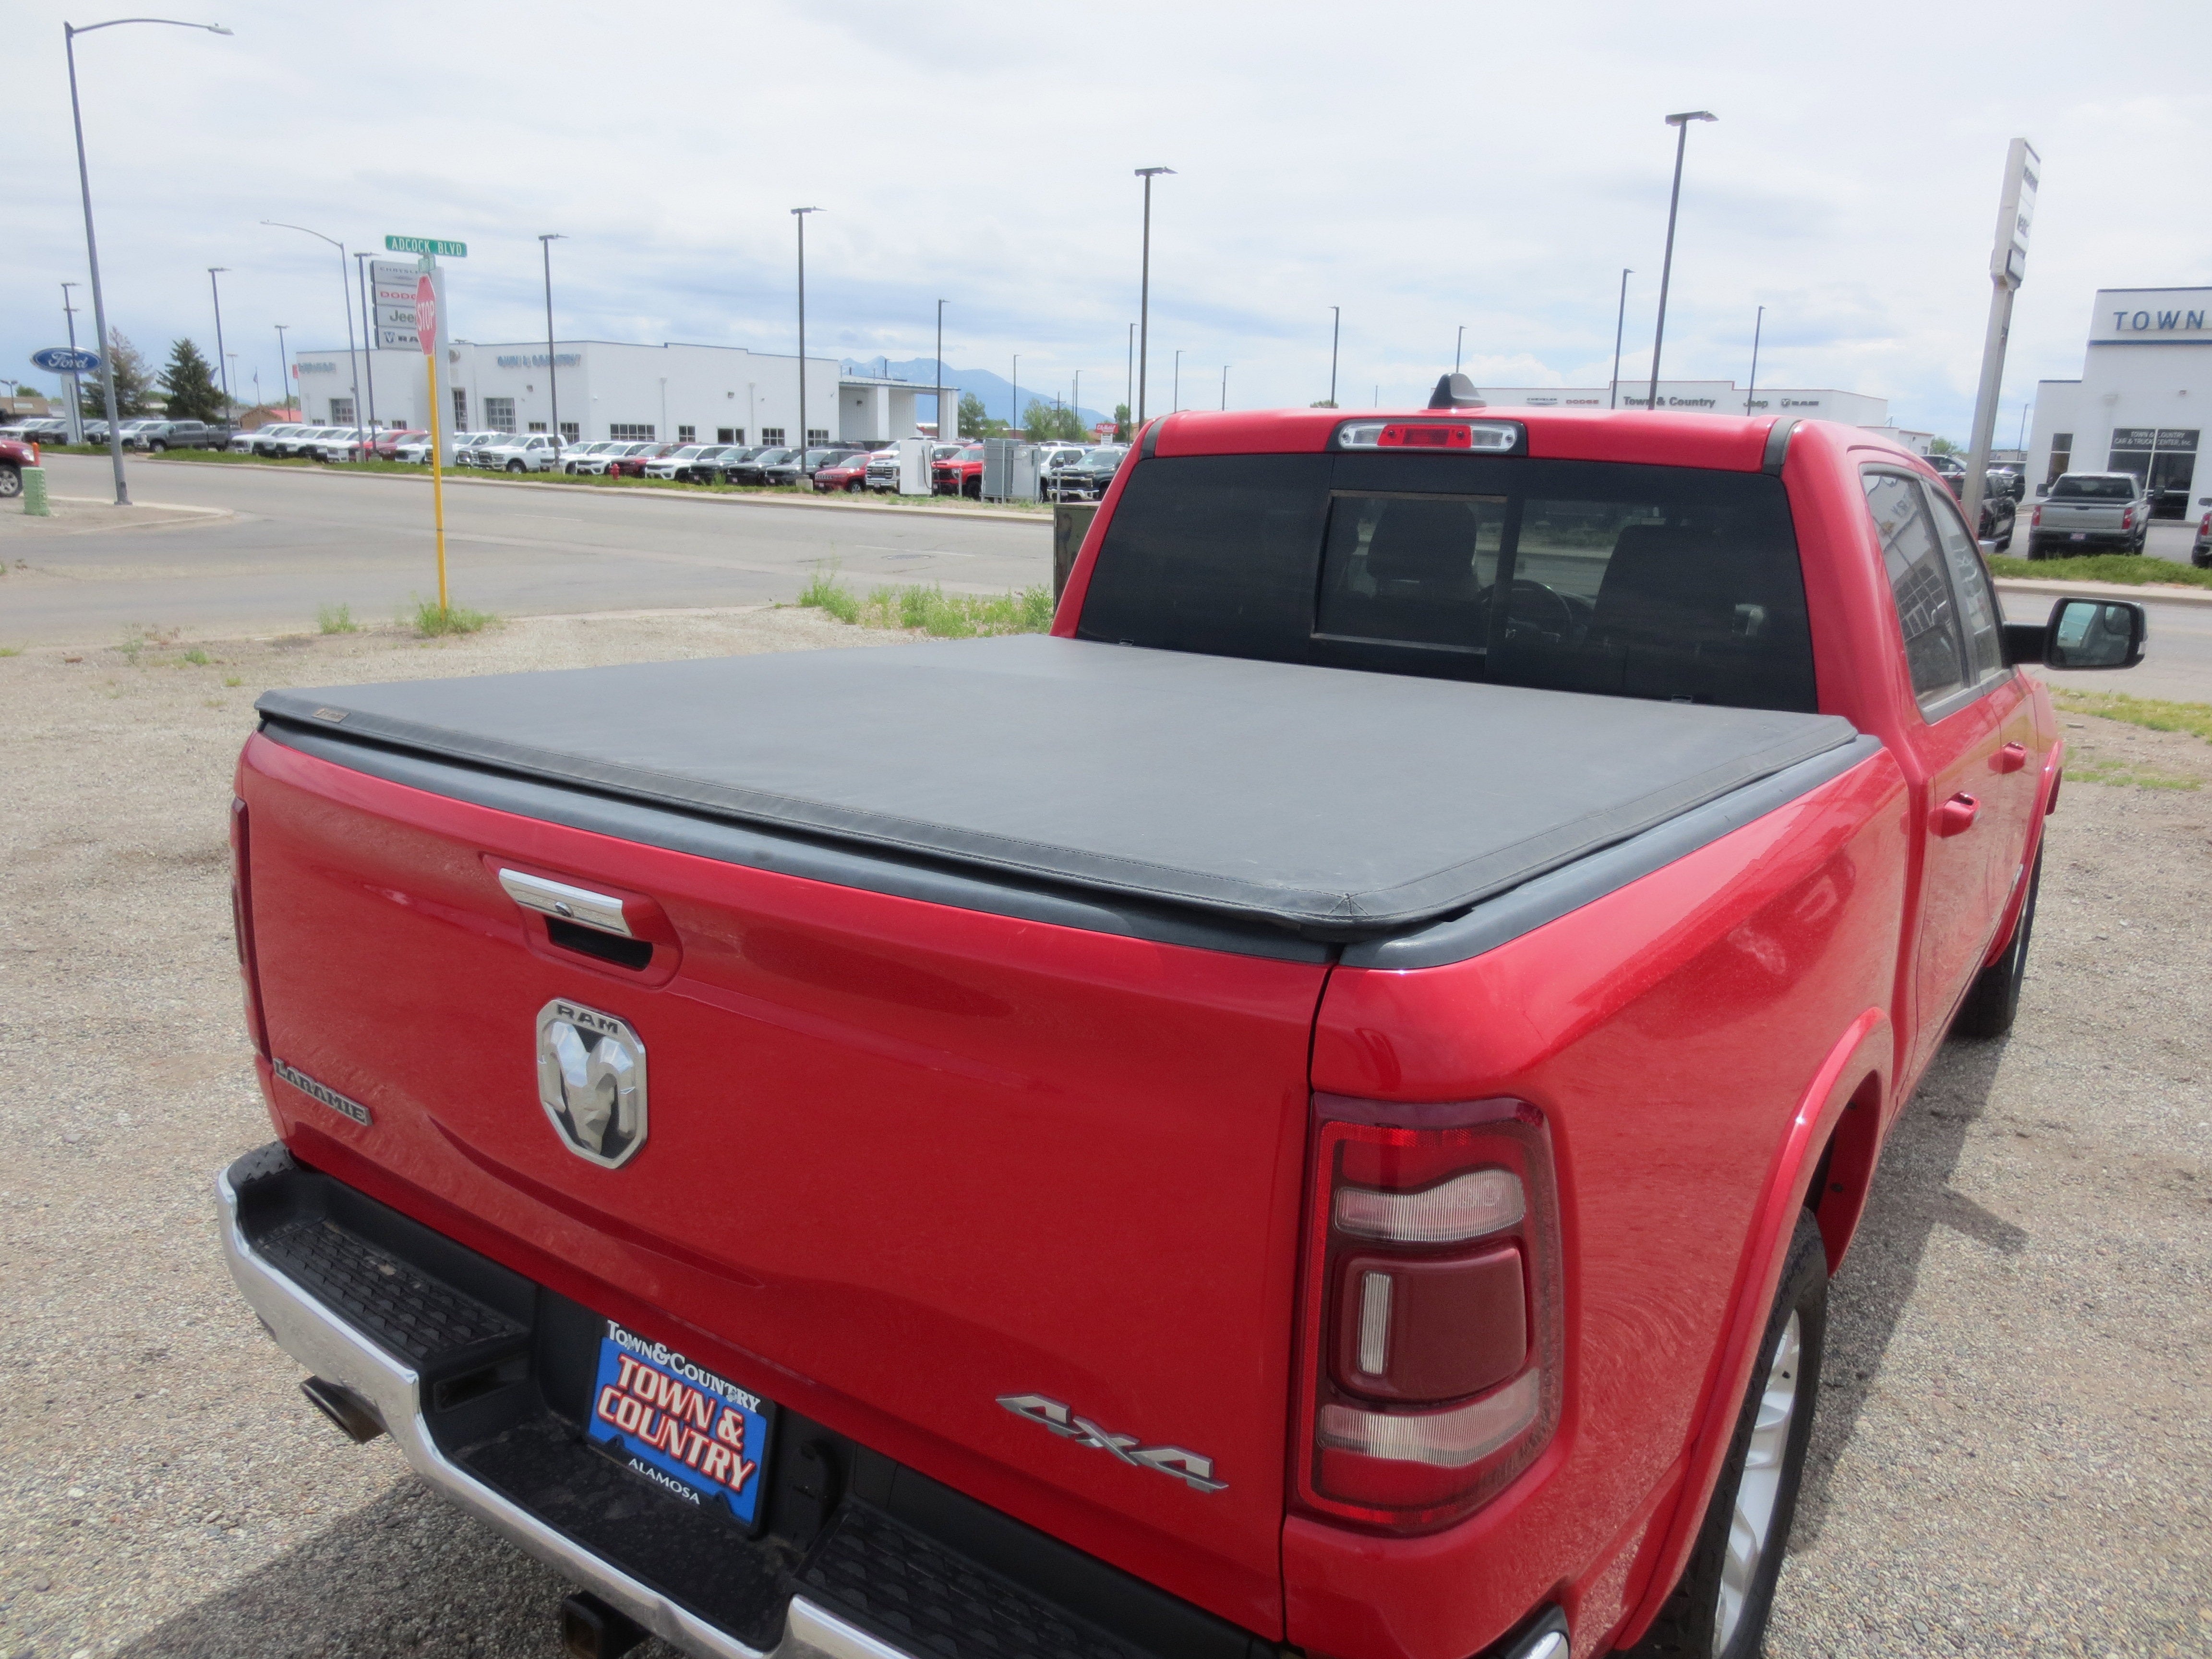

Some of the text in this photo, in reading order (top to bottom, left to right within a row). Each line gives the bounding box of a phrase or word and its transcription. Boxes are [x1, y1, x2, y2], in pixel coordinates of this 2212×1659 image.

[391, 237, 462, 256] ADCOCK BLVD
[389, 310, 417, 325] Jee
[417, 301, 434, 332] STOP
[2113, 310, 2205, 331] TOWN
[1656, 396, 1665, 406] &
[1669, 397, 1716, 409] Country
[556, 1004, 618, 1034] RAM
[274, 1059, 367, 1124] LARAMIE
[618, 1353, 744, 1449] TOWN &
[597, 1384, 756, 1491] COUNTRY
[628, 1458, 700, 1505] ALAMOSA
